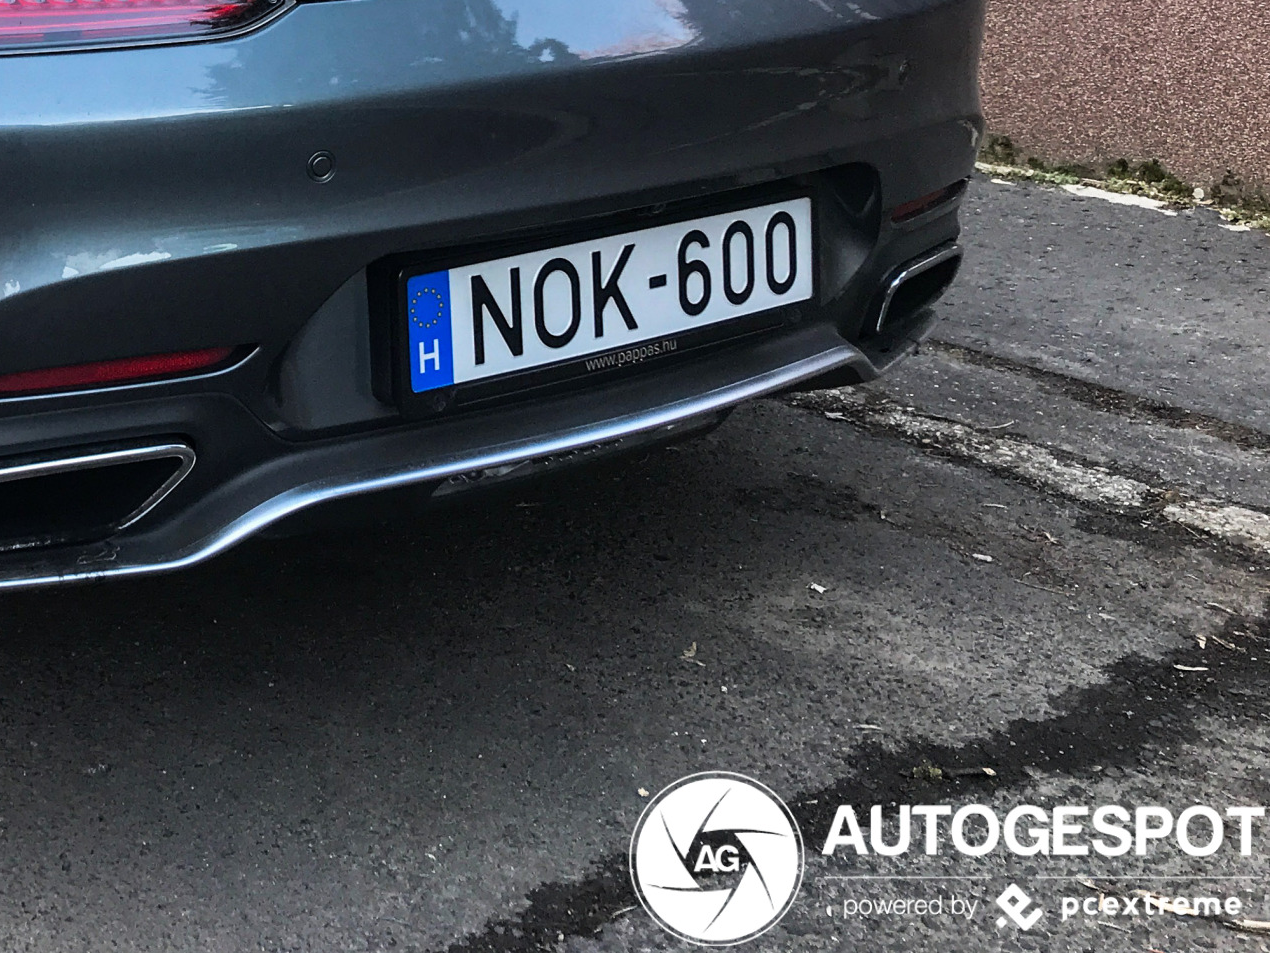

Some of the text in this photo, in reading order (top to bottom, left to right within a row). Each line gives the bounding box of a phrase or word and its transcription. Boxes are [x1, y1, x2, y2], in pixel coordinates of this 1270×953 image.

[470, 211, 797, 366] NOK-600
[419, 338, 440, 374] H
[585, 339, 678, 371] www.pappas.hu
